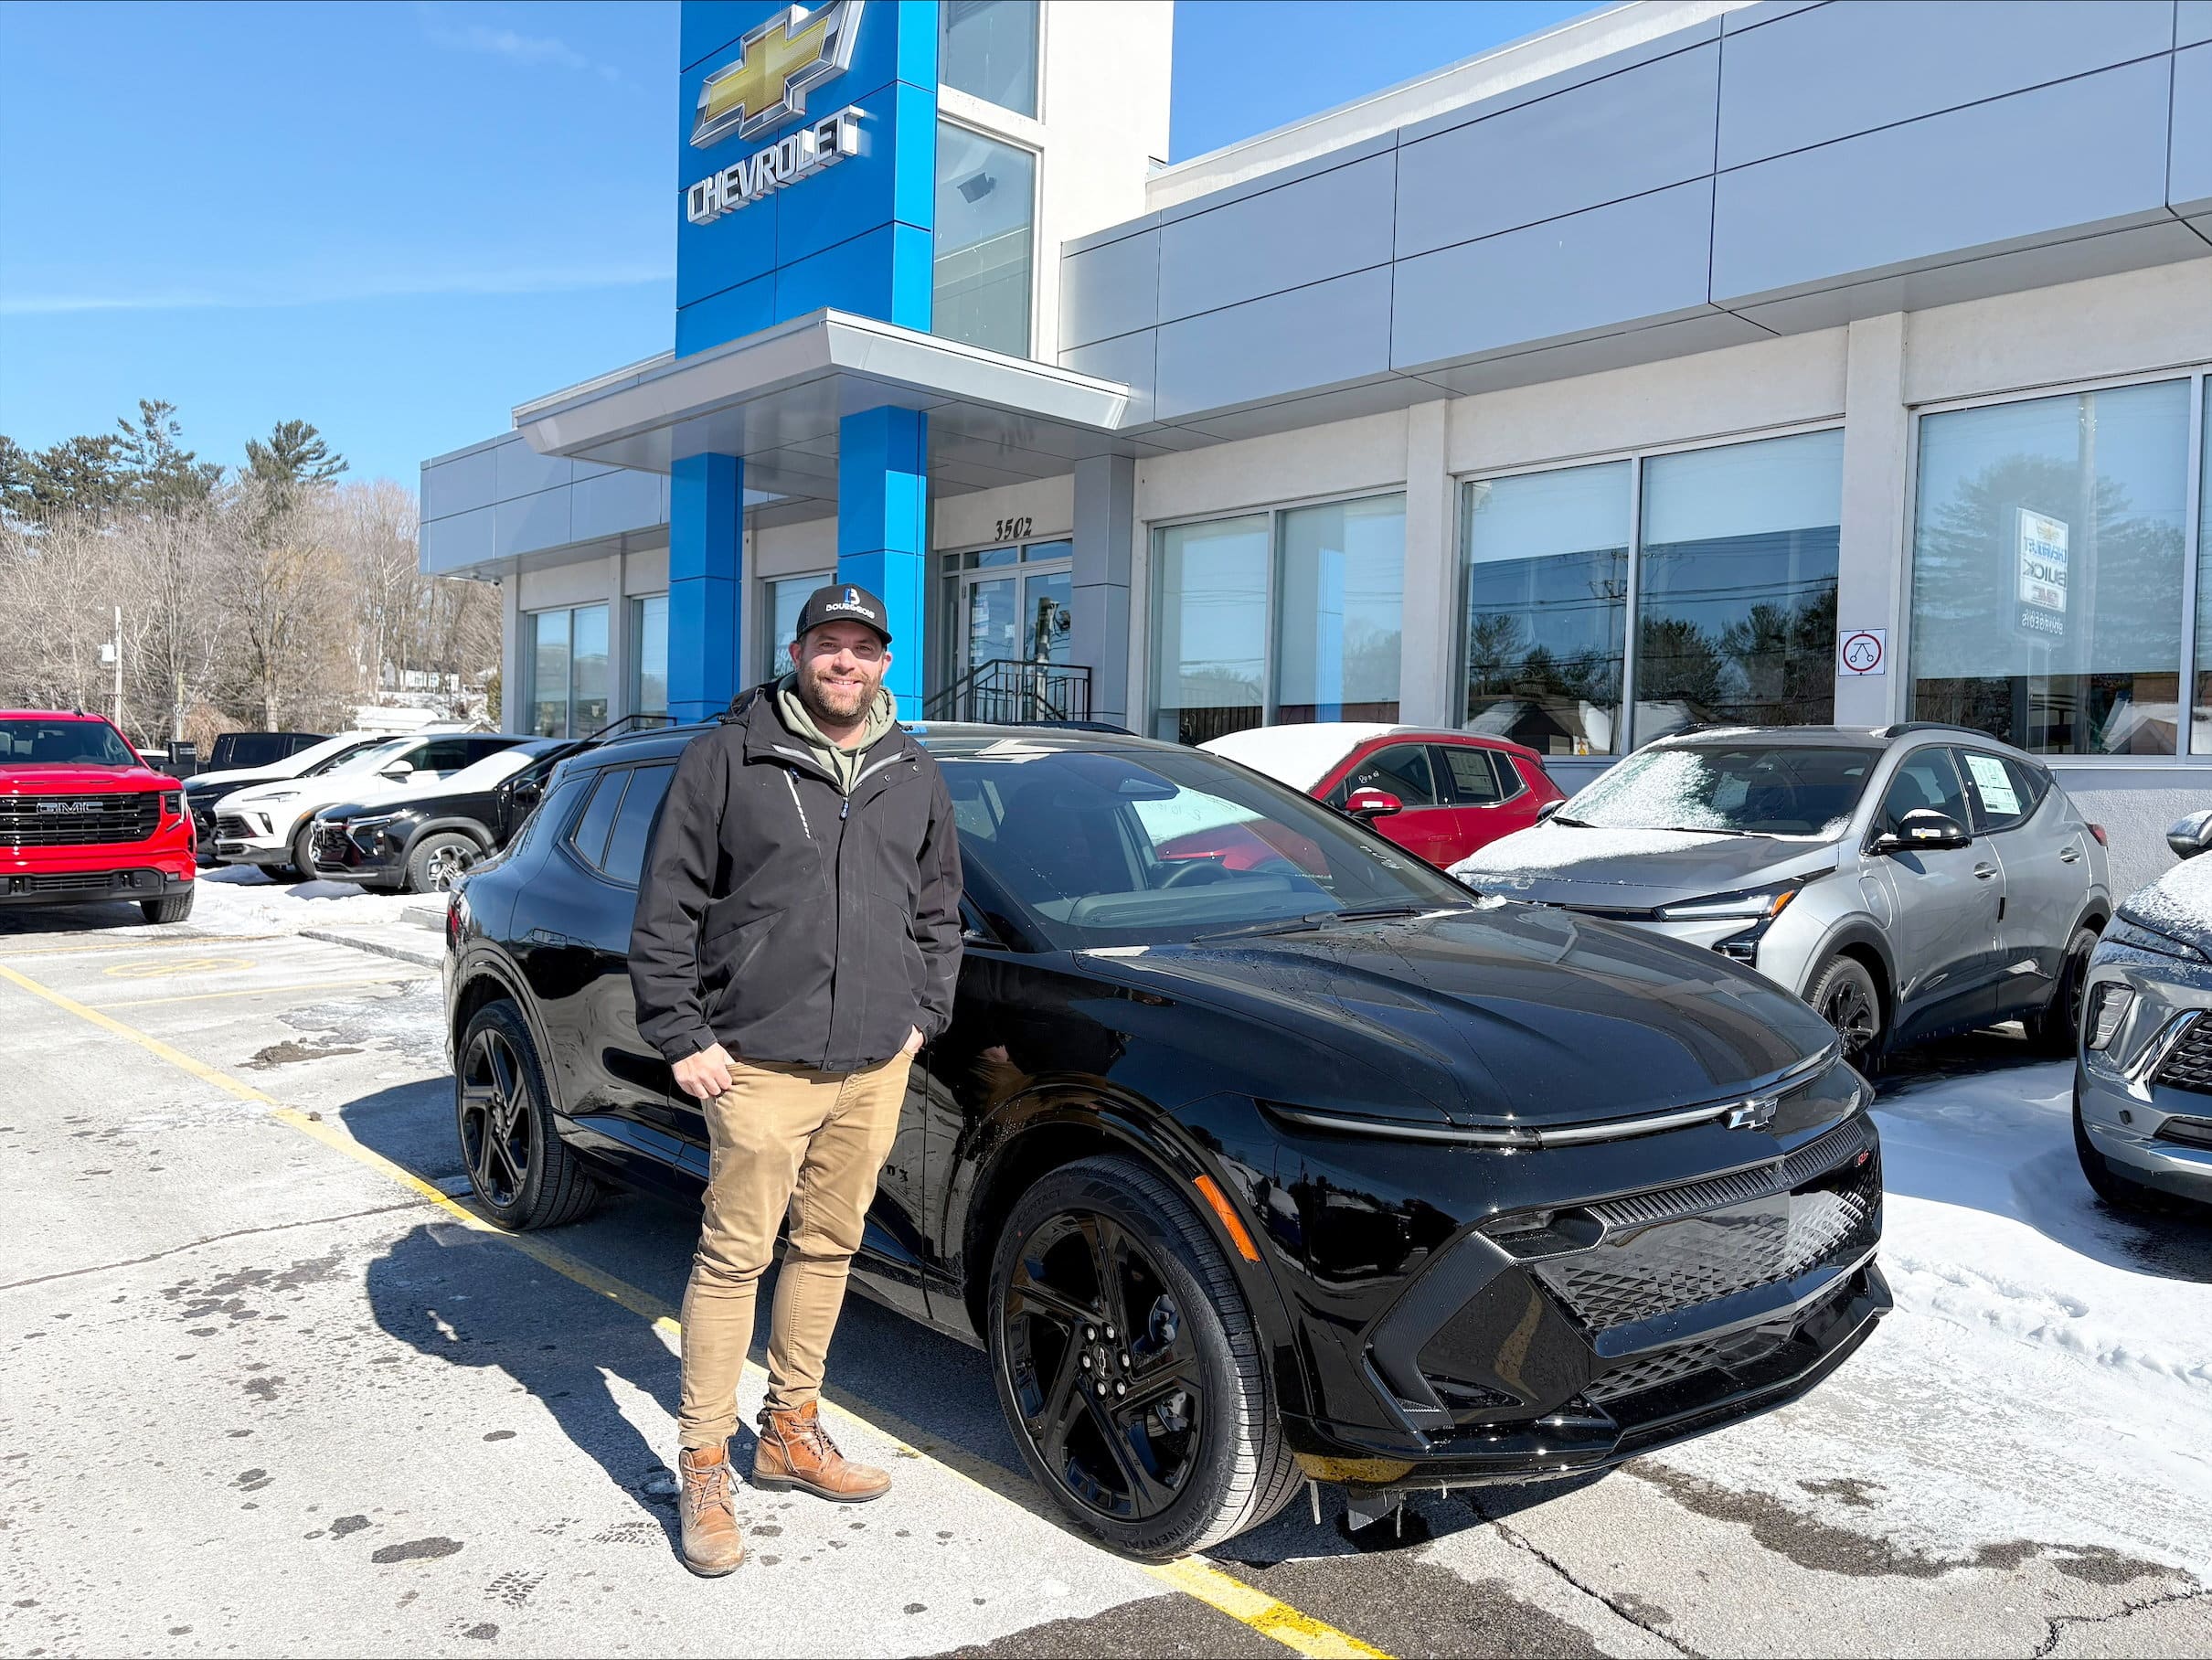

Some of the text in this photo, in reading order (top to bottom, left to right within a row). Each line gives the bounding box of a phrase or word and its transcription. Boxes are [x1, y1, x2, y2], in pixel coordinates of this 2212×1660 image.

[687, 104, 865, 225] CHEVROLET
[994, 517, 1033, 541] 3502
[825, 603, 875, 619] BOURGEOIS
[36, 801, 104, 815] GMC
